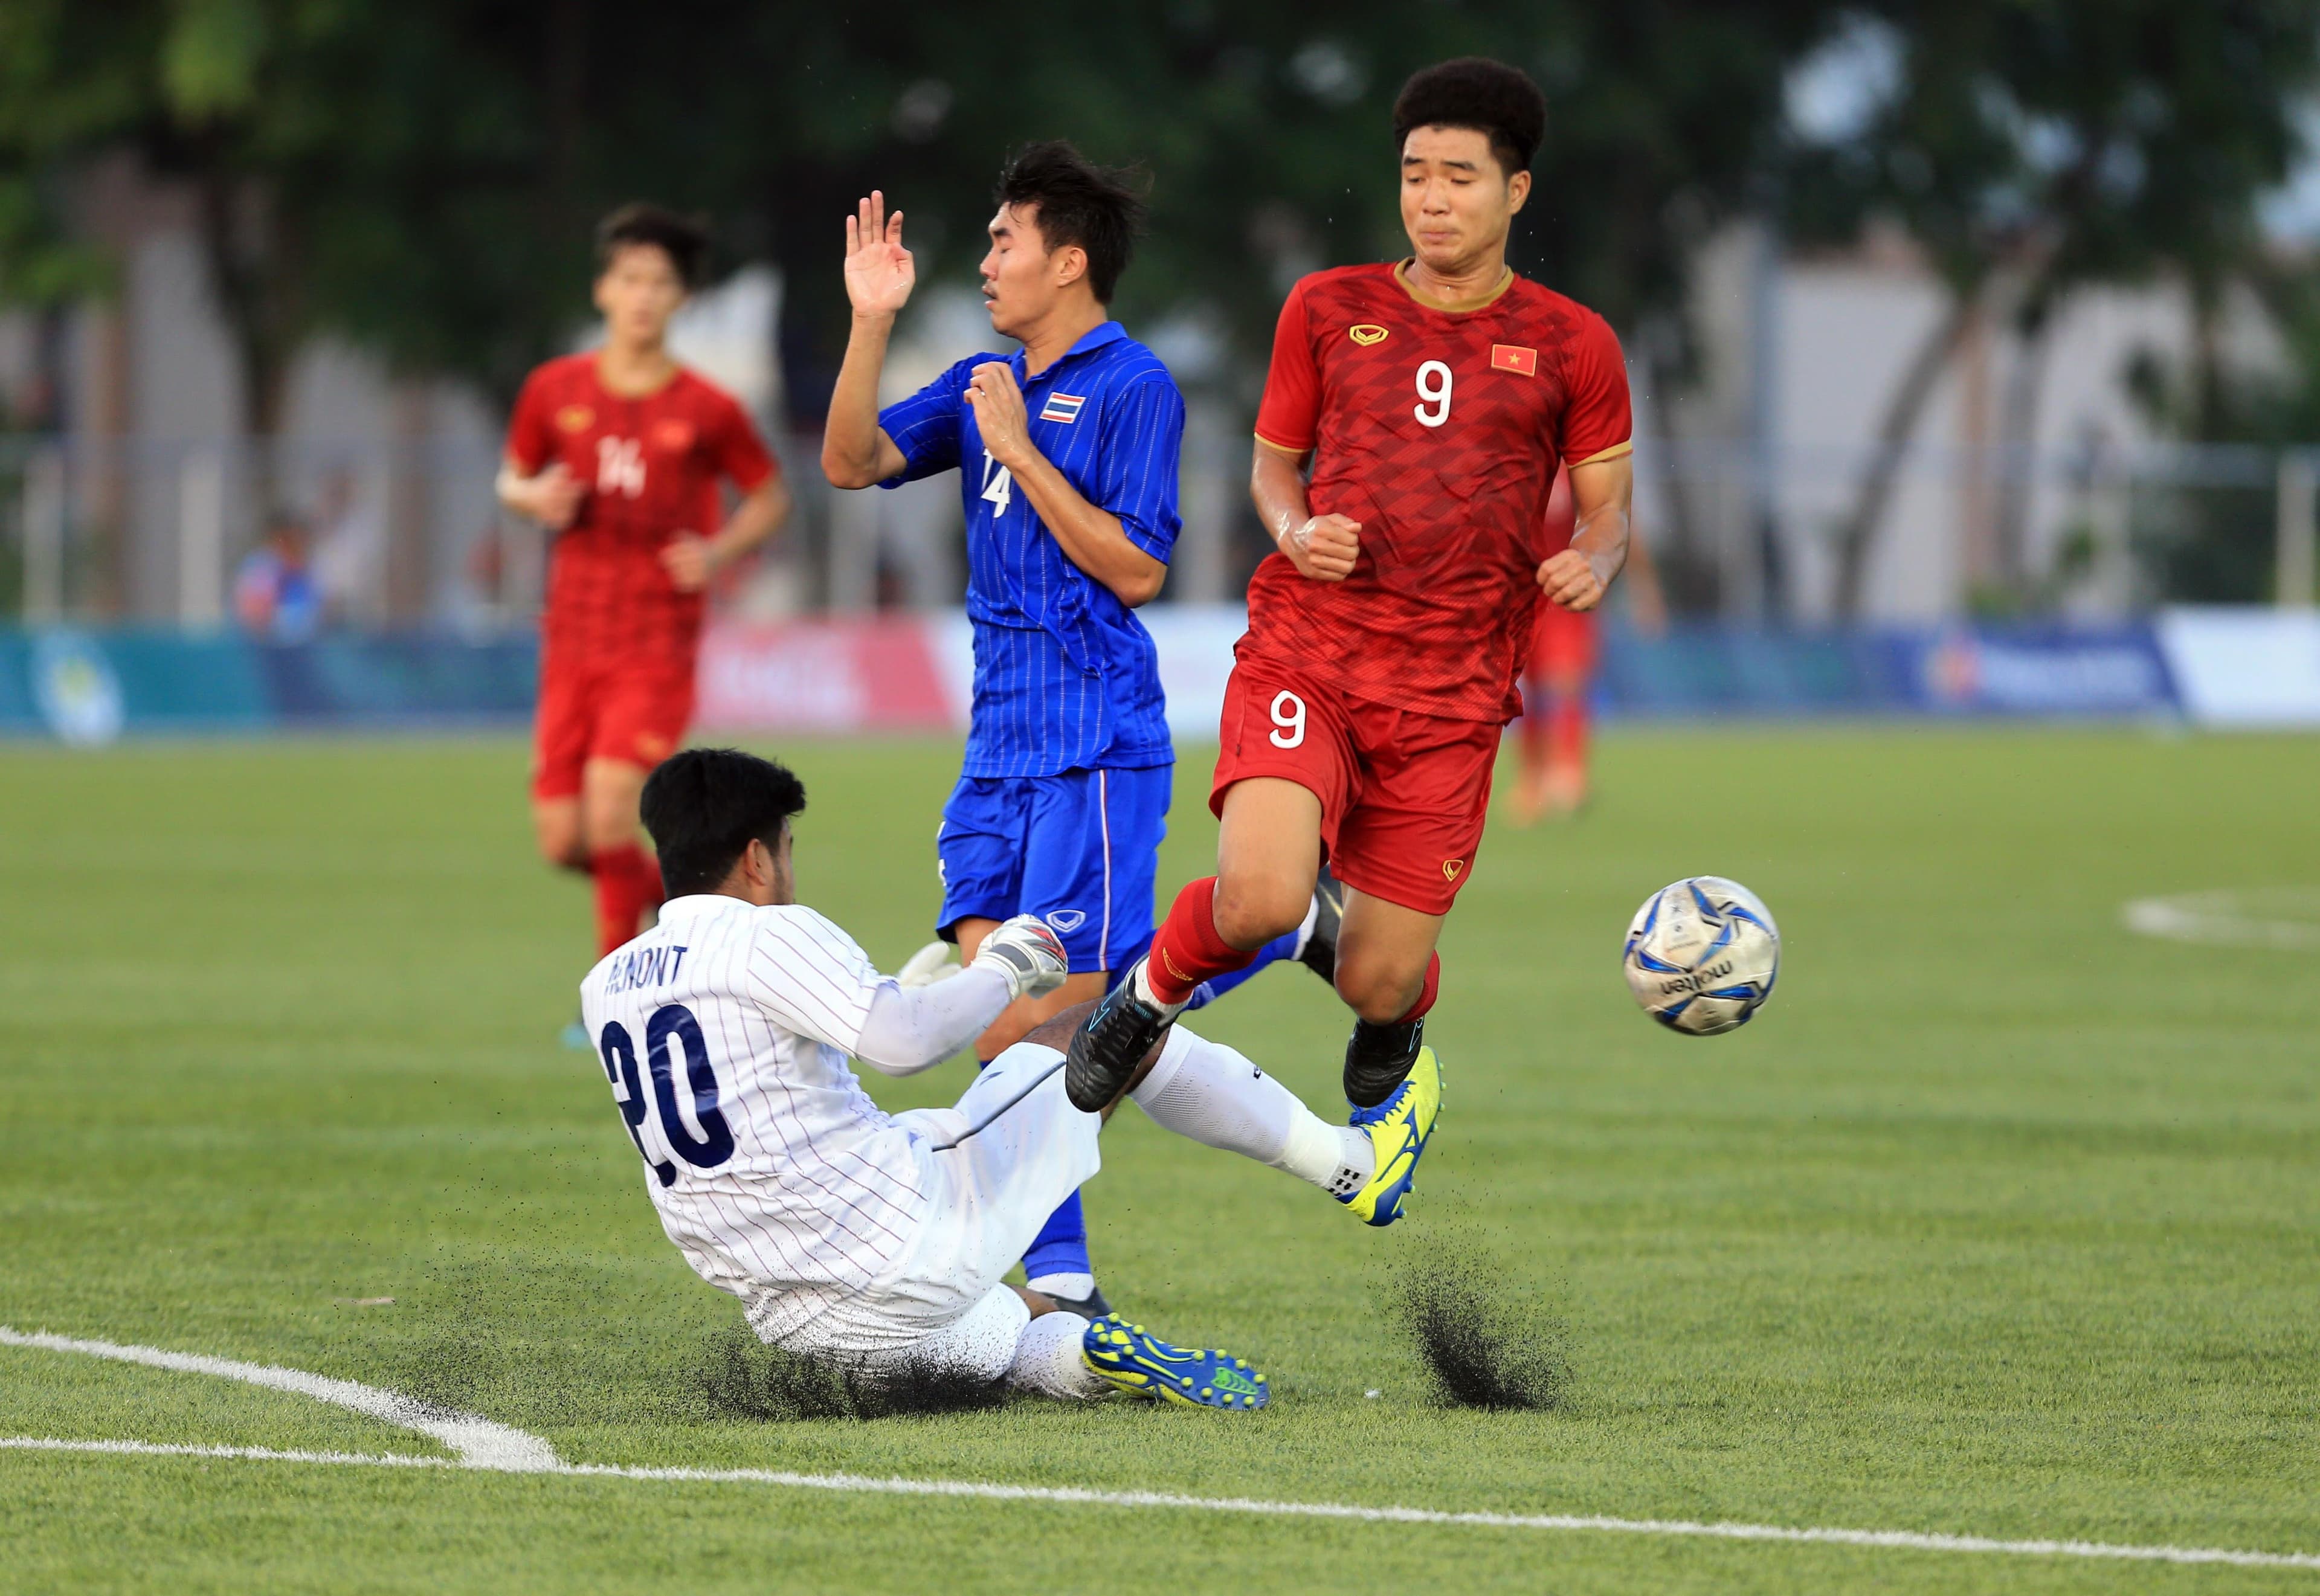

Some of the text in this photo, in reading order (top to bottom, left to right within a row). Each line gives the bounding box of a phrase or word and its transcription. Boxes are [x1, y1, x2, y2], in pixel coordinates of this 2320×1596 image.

[1413, 359, 1454, 428] 9
[595, 434, 646, 500] 14
[981, 447, 1011, 518] 14
[1268, 689, 1307, 750] 9
[1660, 960, 1733, 995] molten
[601, 1003, 735, 1188] 20
